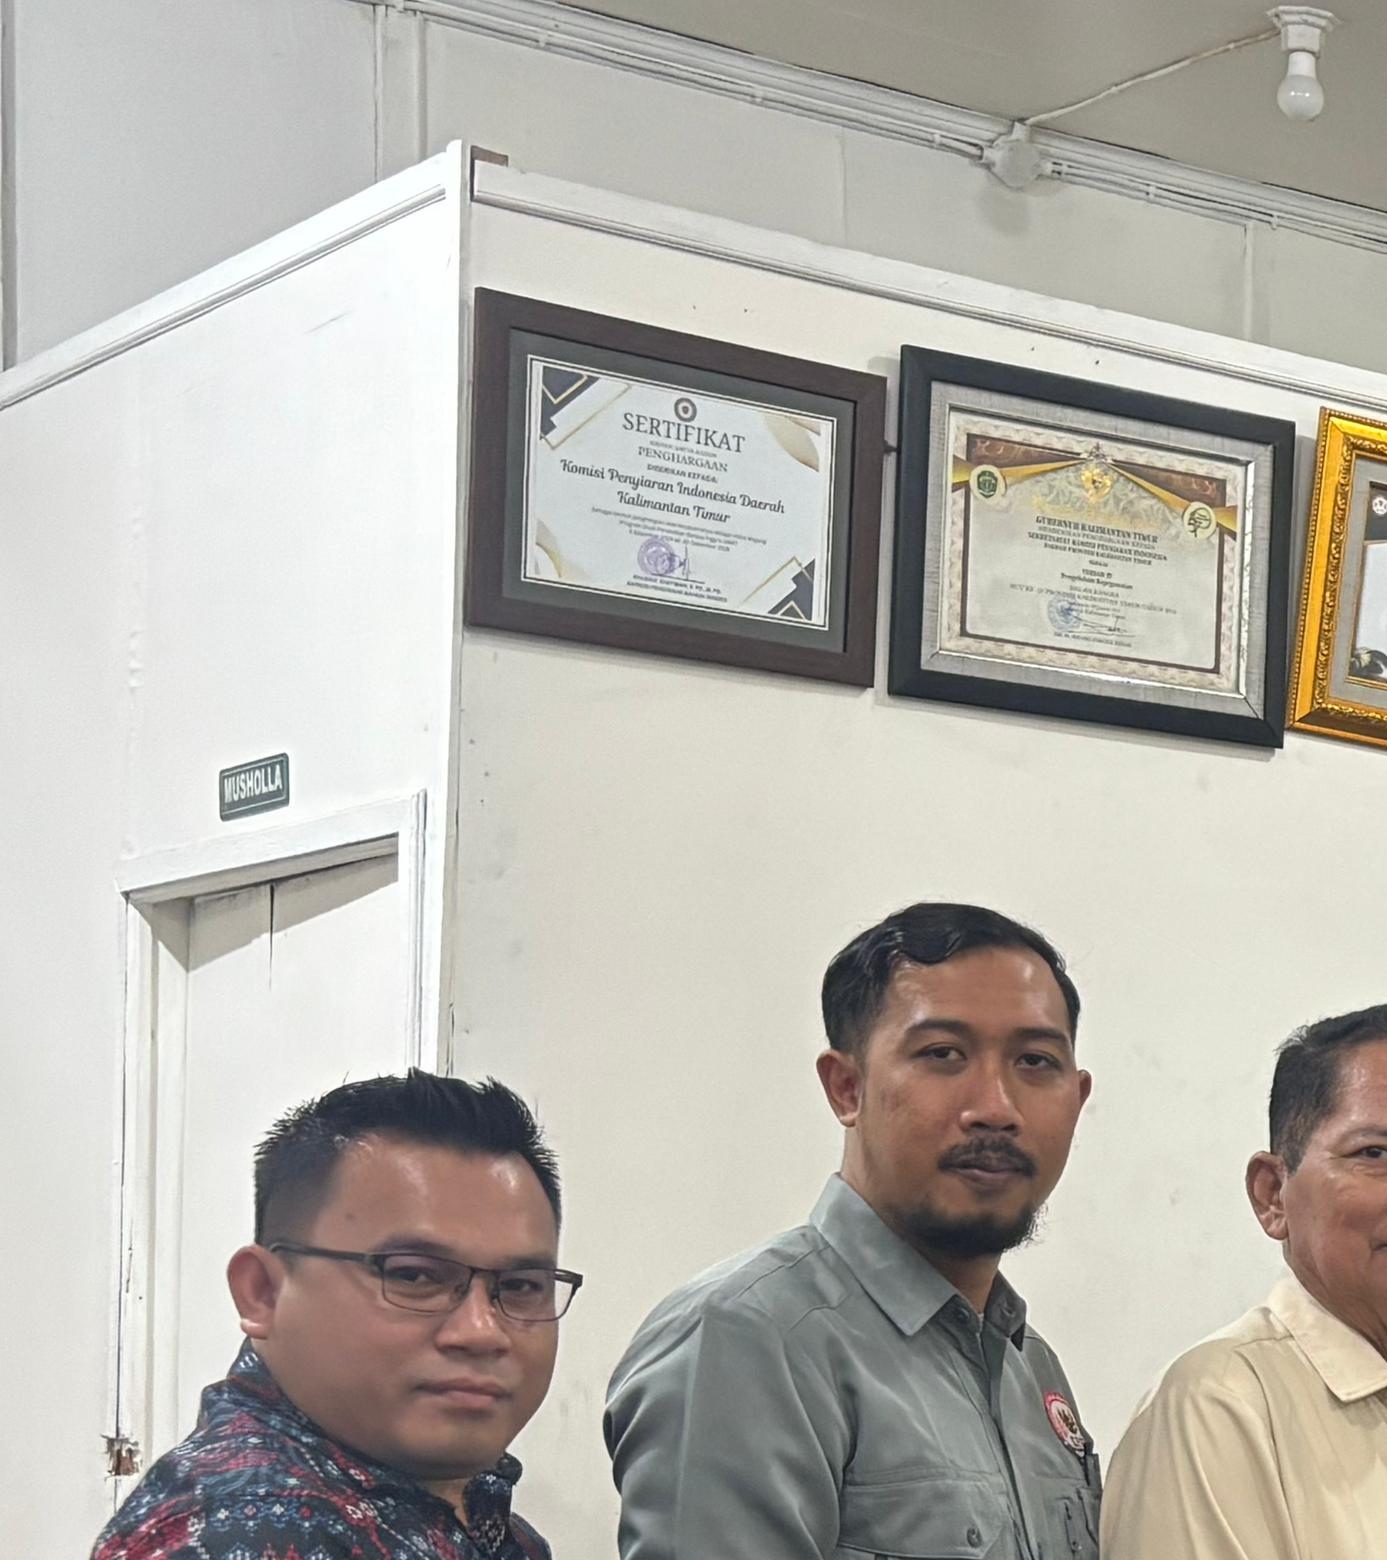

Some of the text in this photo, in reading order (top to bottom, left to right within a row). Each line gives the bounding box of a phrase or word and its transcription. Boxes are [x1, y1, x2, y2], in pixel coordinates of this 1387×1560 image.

[622, 412, 746, 453] SERTIFIKAT
[638, 446, 728, 472] PENGHARGAAN
[560, 459, 785, 514] Komisi Penyiaran Indonesia Daerah
[617, 491, 731, 523] Kalimantan Timur
[224, 764, 283, 803] MUSHOLLA
